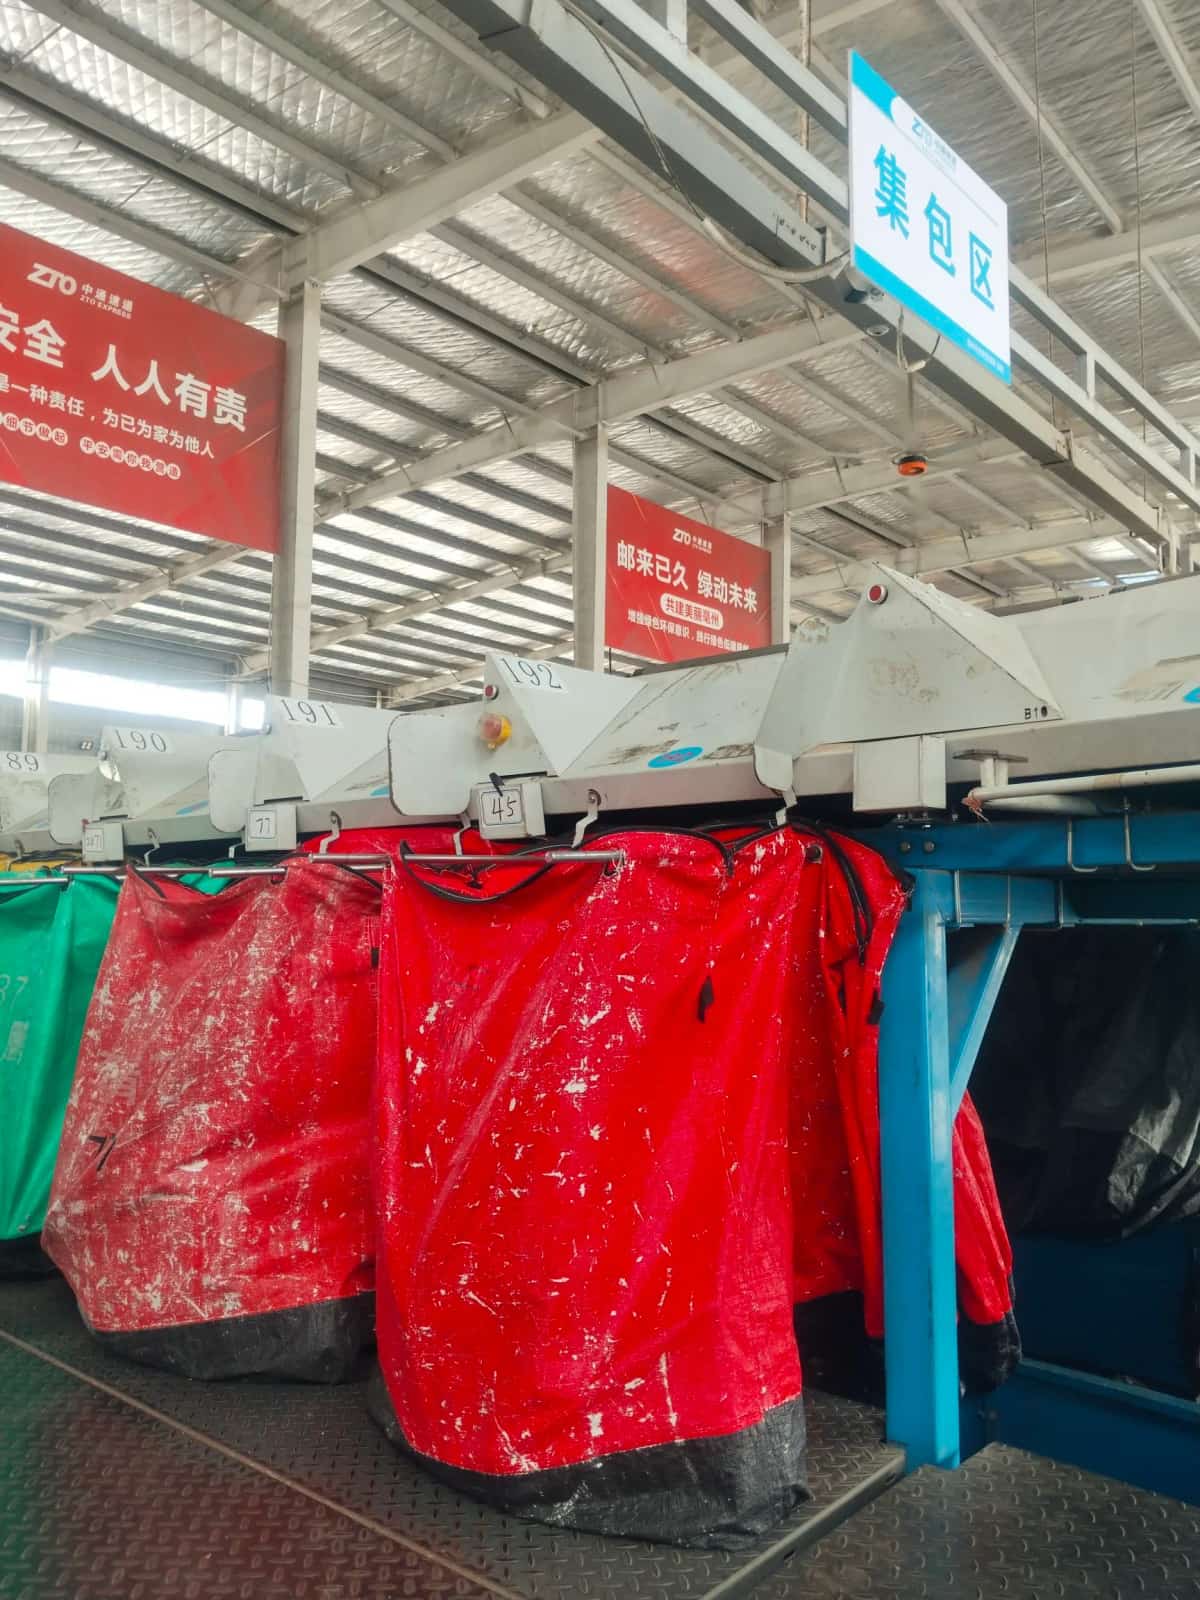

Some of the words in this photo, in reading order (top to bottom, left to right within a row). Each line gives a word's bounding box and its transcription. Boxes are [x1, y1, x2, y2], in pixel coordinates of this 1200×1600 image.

[874, 143, 995, 312] 集包区
[27, 262, 77, 295] ZTO
[91, 343, 248, 432] 人人有责
[672, 527, 691, 545] ZTO
[616, 540, 689, 591] 邮来已久
[697, 570, 758, 614] 绿动未来
[501, 657, 562, 690] 192
[282, 699, 336, 727] 191
[115, 729, 167, 753] 190
[491, 796, 517, 824] 45
